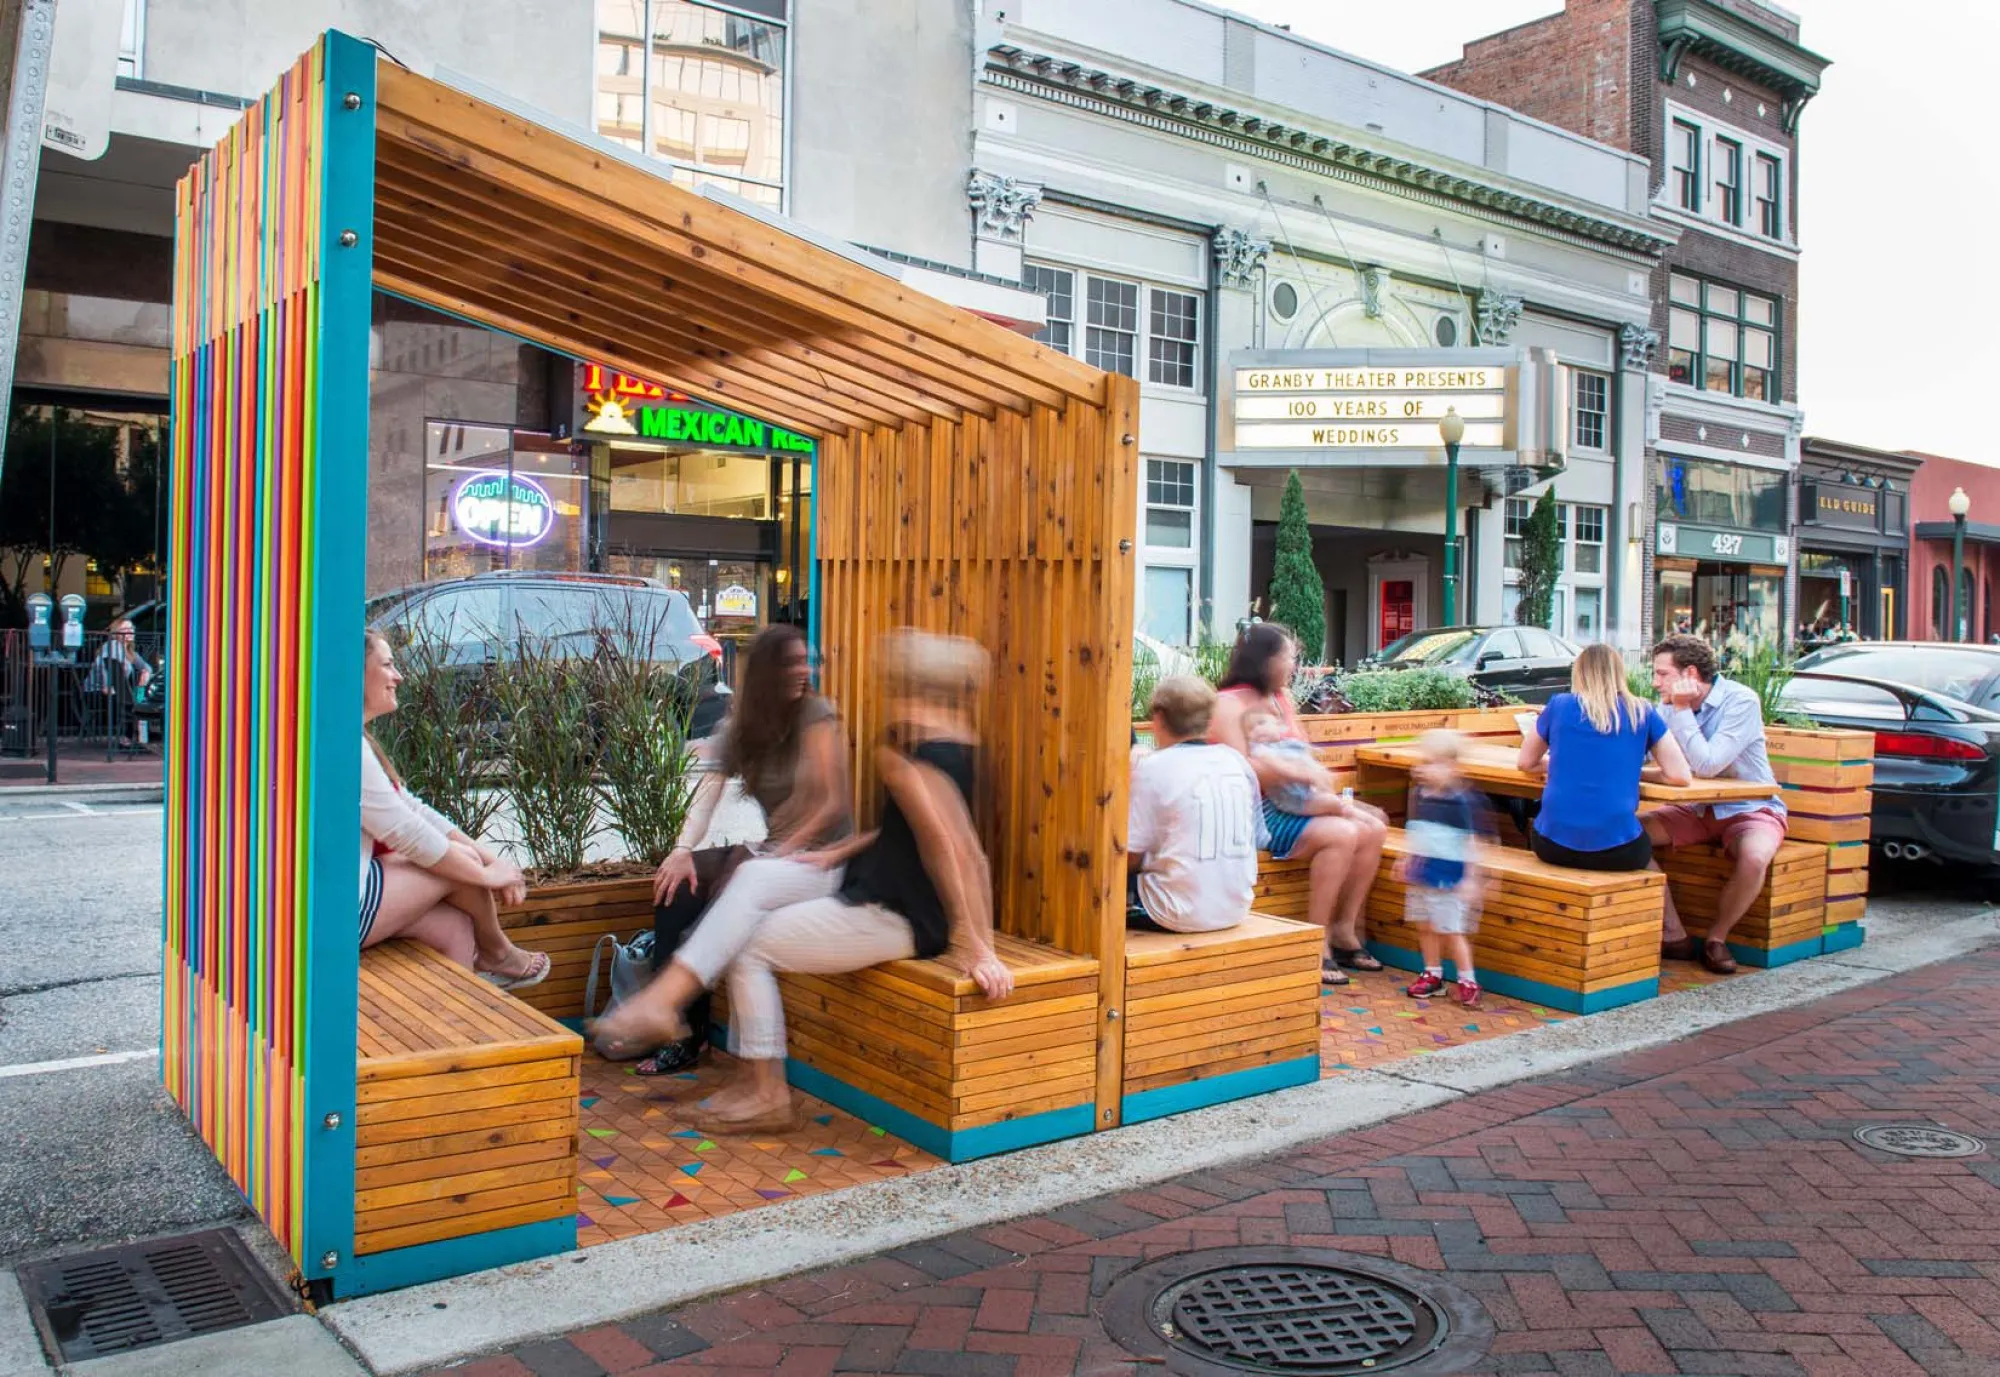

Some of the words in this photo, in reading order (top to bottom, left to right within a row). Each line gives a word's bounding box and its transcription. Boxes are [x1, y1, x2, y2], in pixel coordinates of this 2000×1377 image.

[1249, 373, 1315, 388] GRANBY
[1325, 373, 1396, 387] THEATER
[1405, 371, 1486, 386] PRESENTS
[1288, 401, 1317, 416] 100
[1333, 401, 1388, 416] YEARS
[1404, 401, 1423, 416] OF
[642, 405, 764, 447] MEXICAN
[1313, 428, 1399, 444] WEDDINGS
[1842, 500, 1876, 515] GUIDE
[457, 497, 543, 536] OPEN
[1711, 533, 1743, 555] 427
